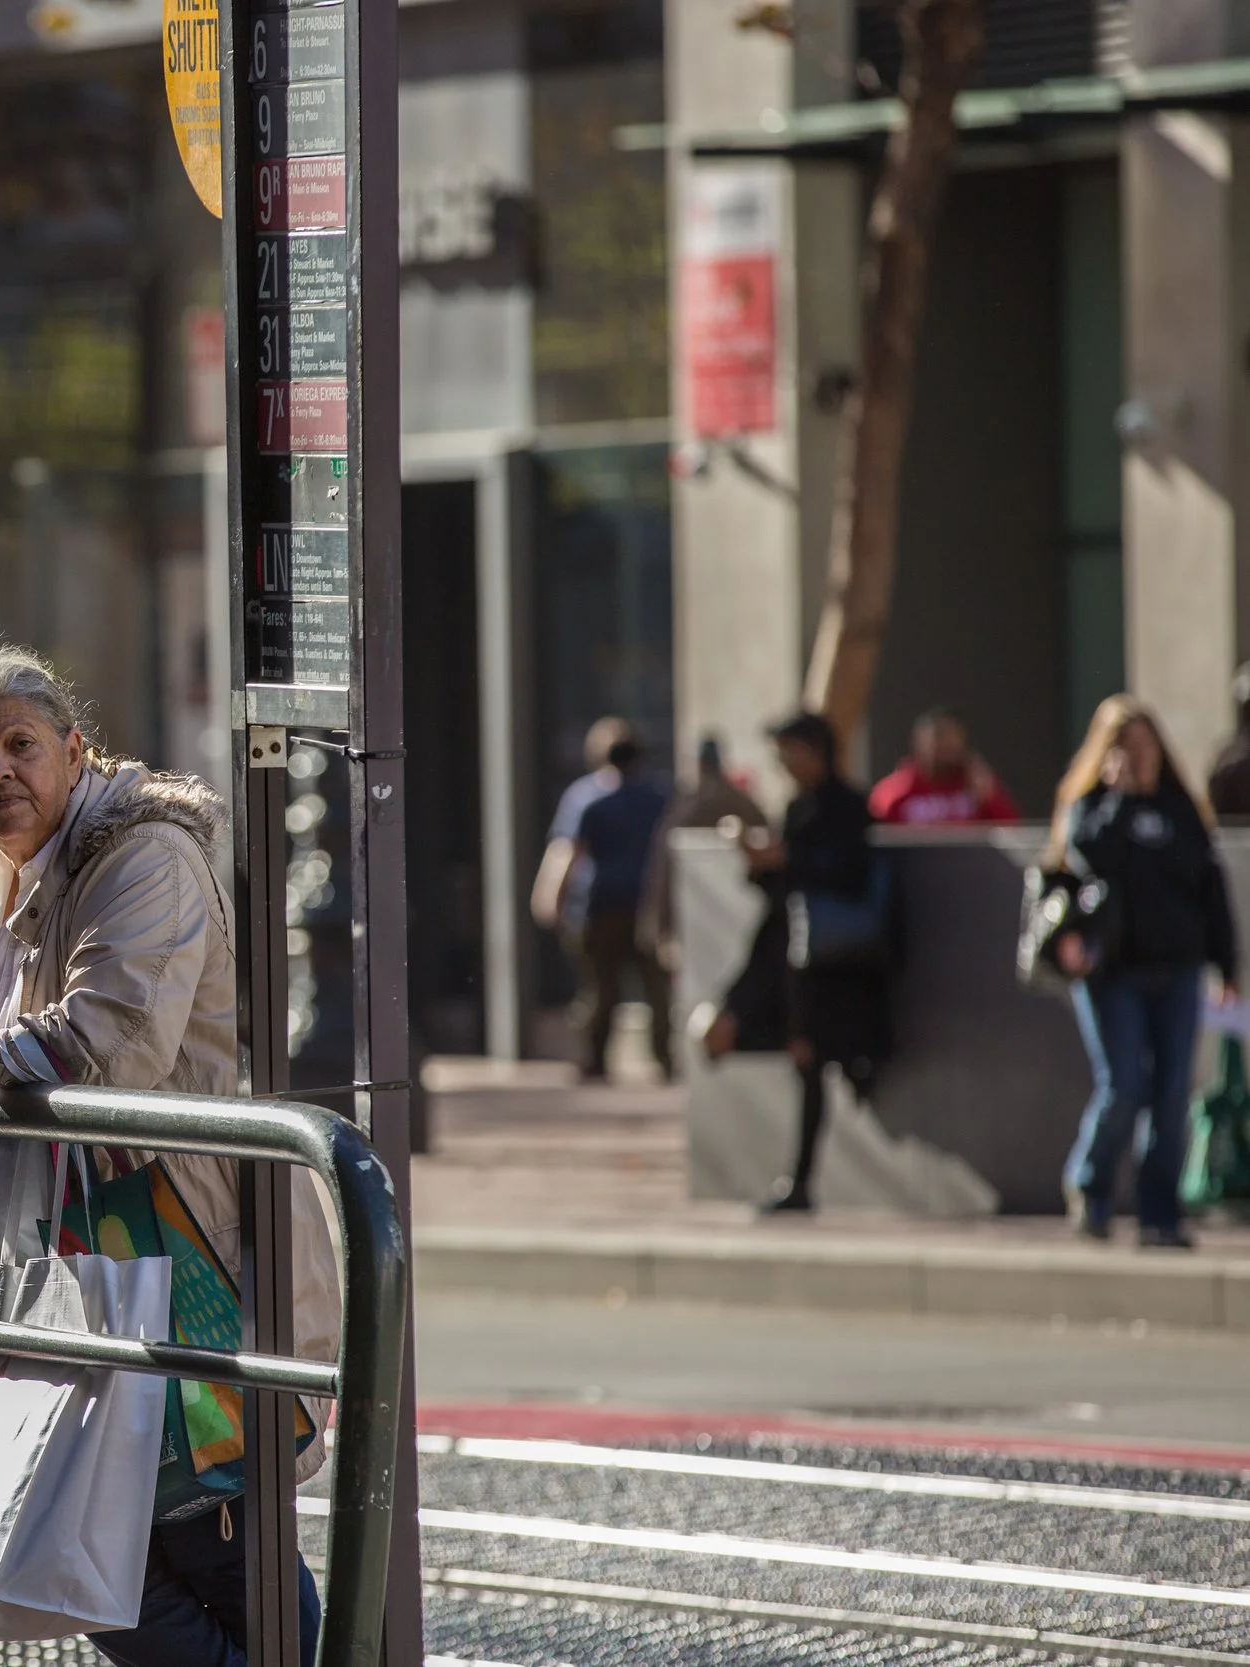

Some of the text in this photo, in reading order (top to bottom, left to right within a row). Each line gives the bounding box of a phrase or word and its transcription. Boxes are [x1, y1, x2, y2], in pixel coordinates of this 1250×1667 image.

[167, 19, 219, 73] SHUTTL
[254, 19, 267, 80] 6
[258, 95, 271, 154] 9
[300, 89, 326, 106] BRUNO
[301, 162, 326, 178] BRUNO
[257, 240, 279, 300] 21
[259, 314, 280, 373] 31
[291, 312, 315, 328] ALBOA
[261, 606, 288, 627] Fares:
